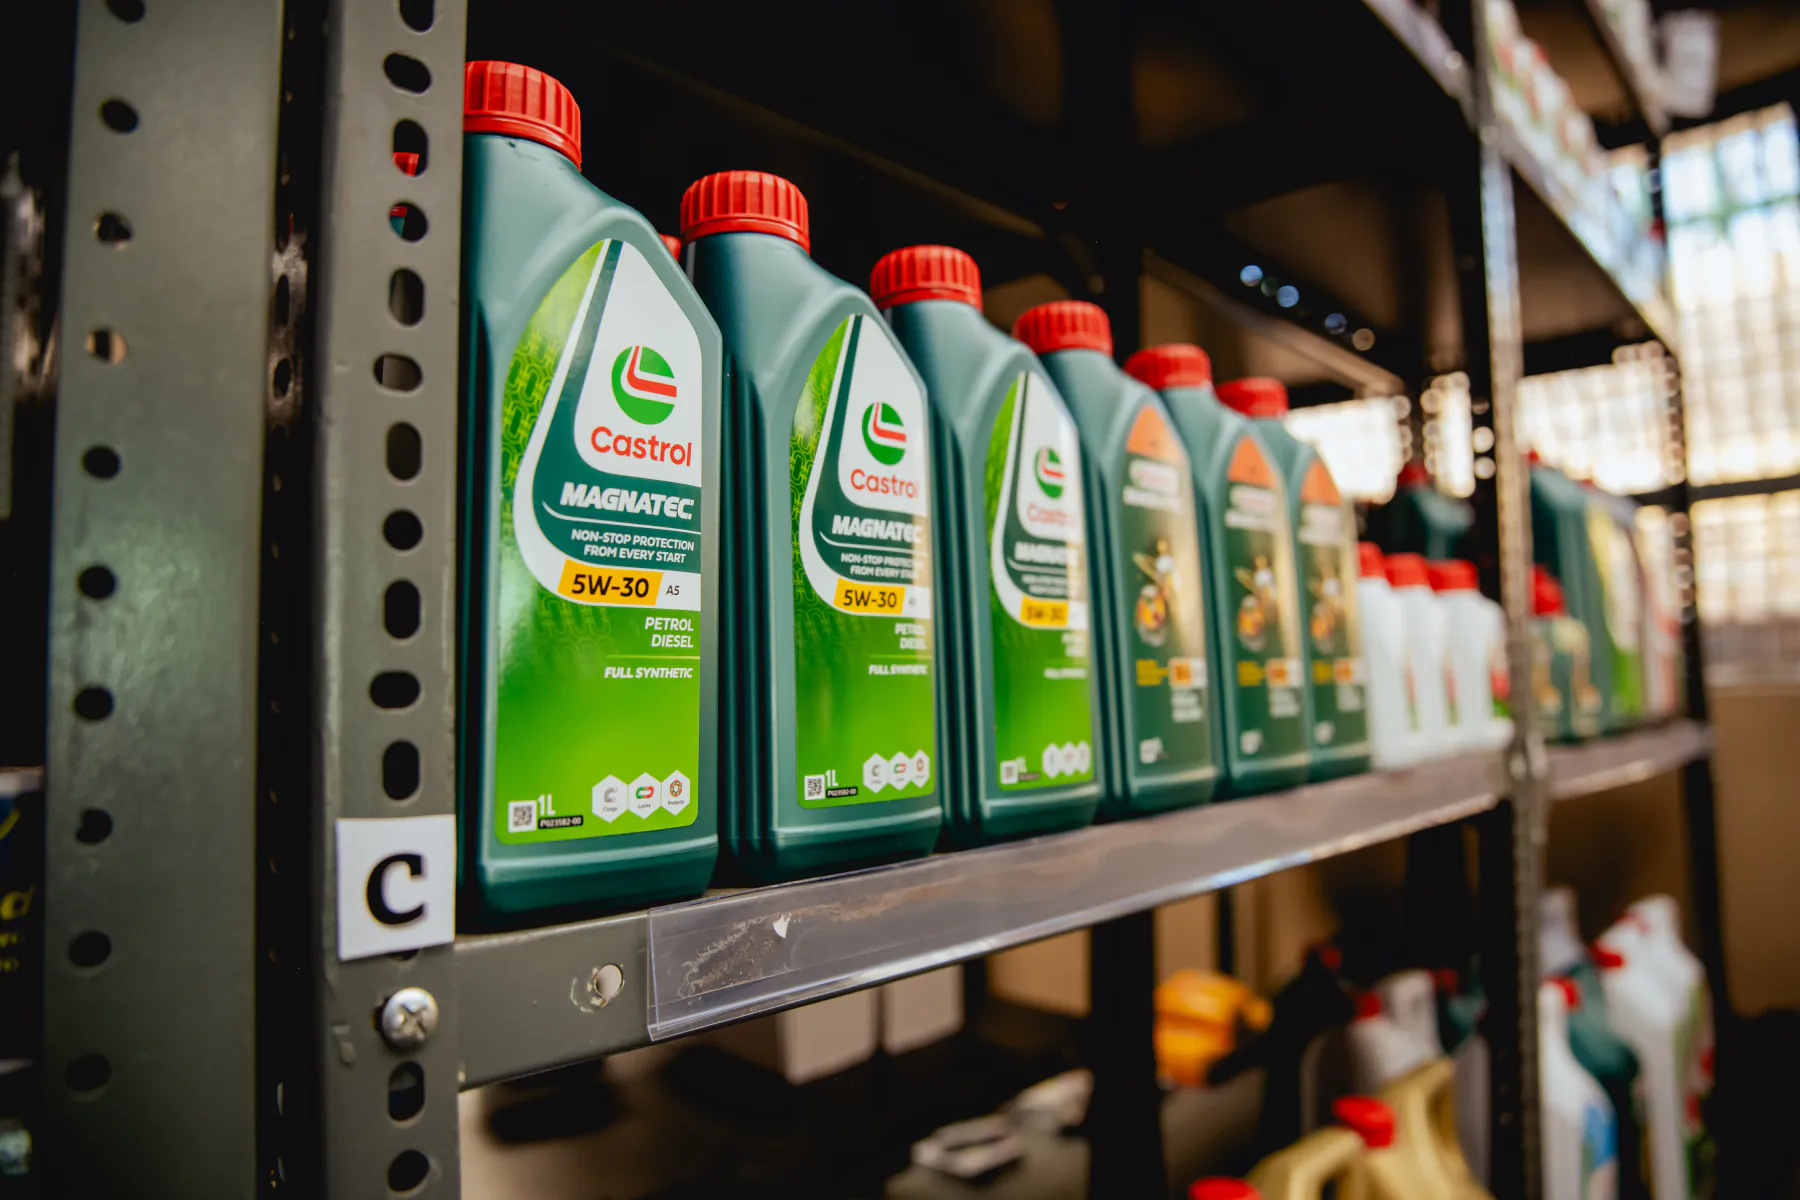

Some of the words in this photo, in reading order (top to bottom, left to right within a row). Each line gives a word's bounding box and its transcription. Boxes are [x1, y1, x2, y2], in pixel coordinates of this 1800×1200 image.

[590, 426, 692, 467] Castrol
[560, 482, 695, 520] MAGNATEC
[831, 514, 923, 543] MAGNATEC
[571, 529, 631, 545] NON-STOP
[632, 534, 694, 551] PROTECTION
[583, 544, 617, 558] FROM
[619, 547, 655, 561] EVERY
[655, 551, 686, 563] START
[850, 564, 874, 576] FROM
[571, 573, 650, 598] 5W-30
[665, 585, 680, 596] A5
[843, 589, 897, 608] 5W-30
[644, 616, 694, 632] PETROL
[651, 634, 694, 648] DIESEL
[604, 667, 633, 678] FULL
[635, 667, 693, 678] SYNTHETIC
[825, 769, 838, 787] 1L
[538, 793, 556, 816] 1L
[365, 853, 427, 925] C
